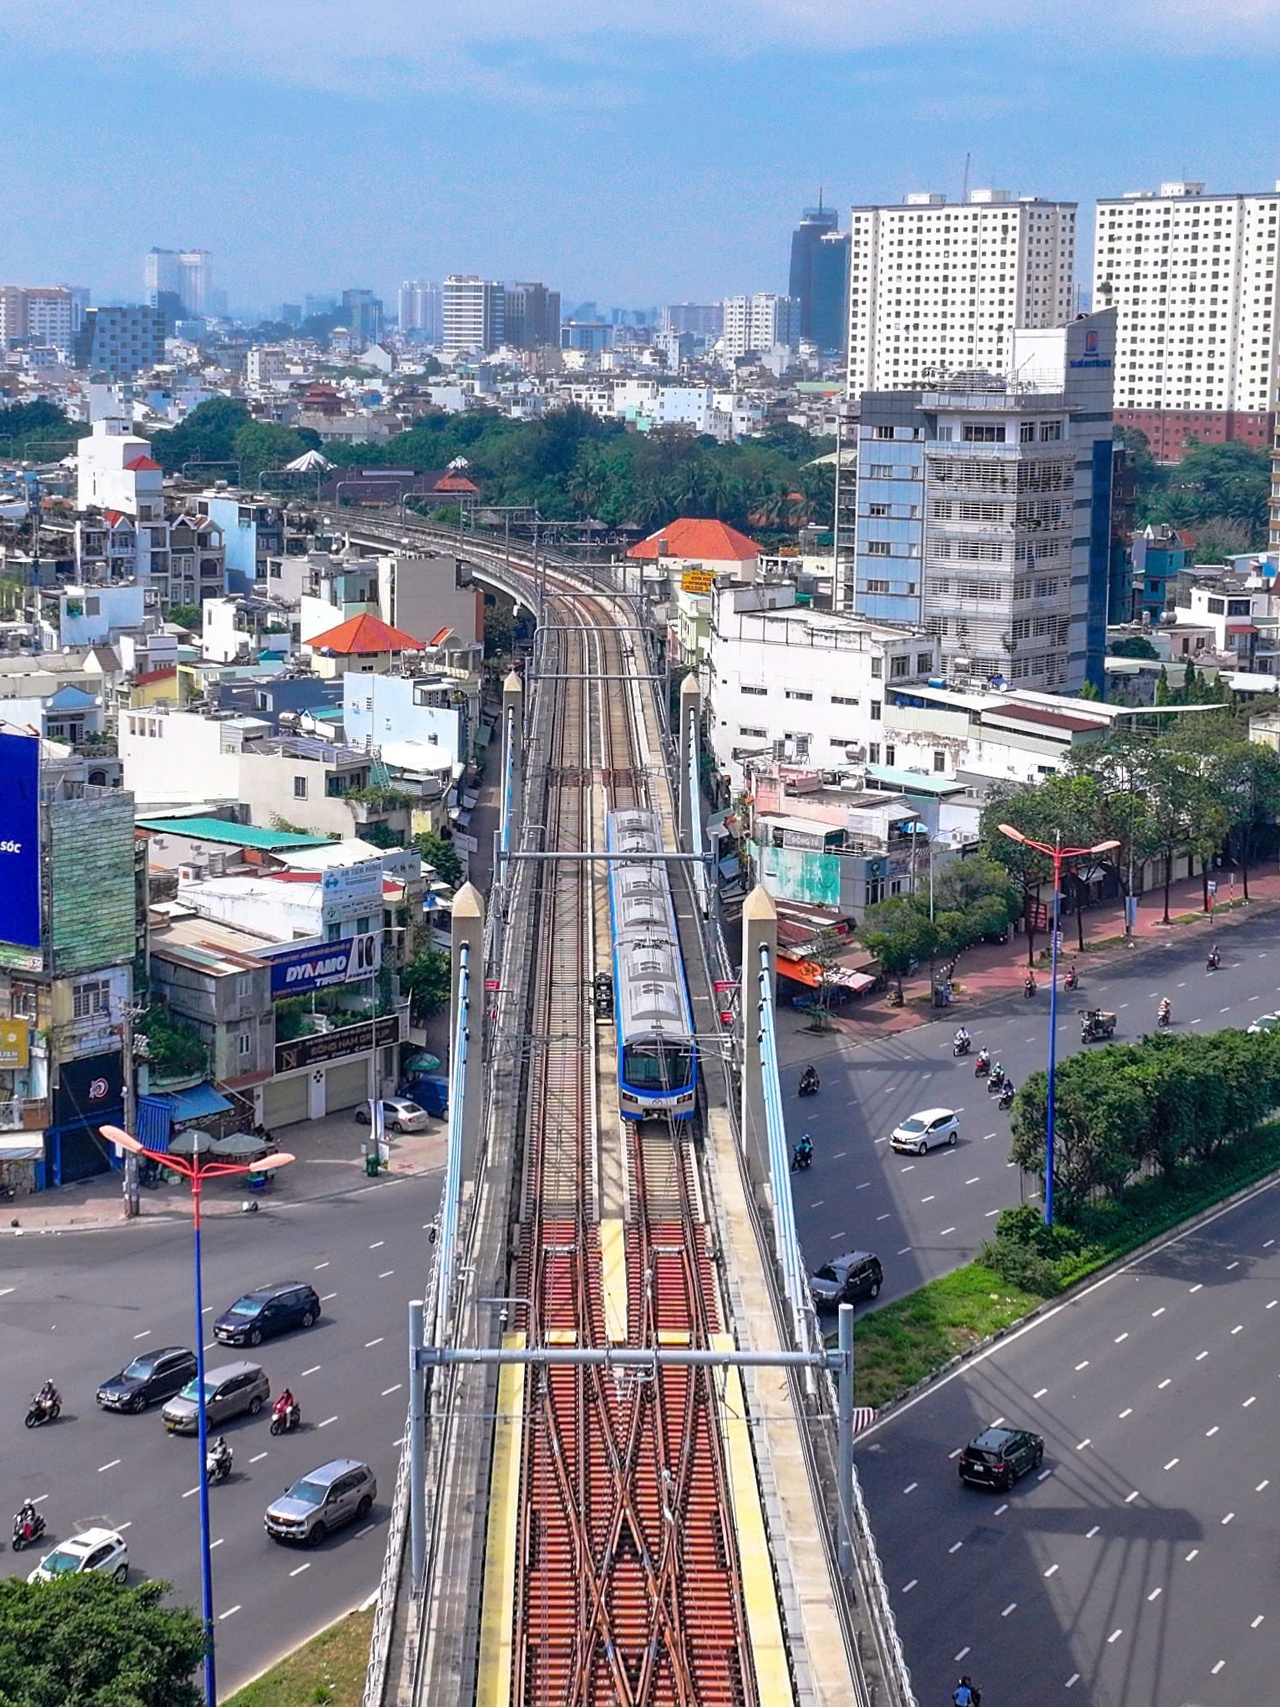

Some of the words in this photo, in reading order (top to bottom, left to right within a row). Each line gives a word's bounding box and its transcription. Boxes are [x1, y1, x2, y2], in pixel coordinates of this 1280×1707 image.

[0, 840, 21, 853] SÓC
[286, 955, 347, 982] DYNAMO
[315, 973, 345, 987] TIRES
[340, 1036, 358, 1048] NAM
